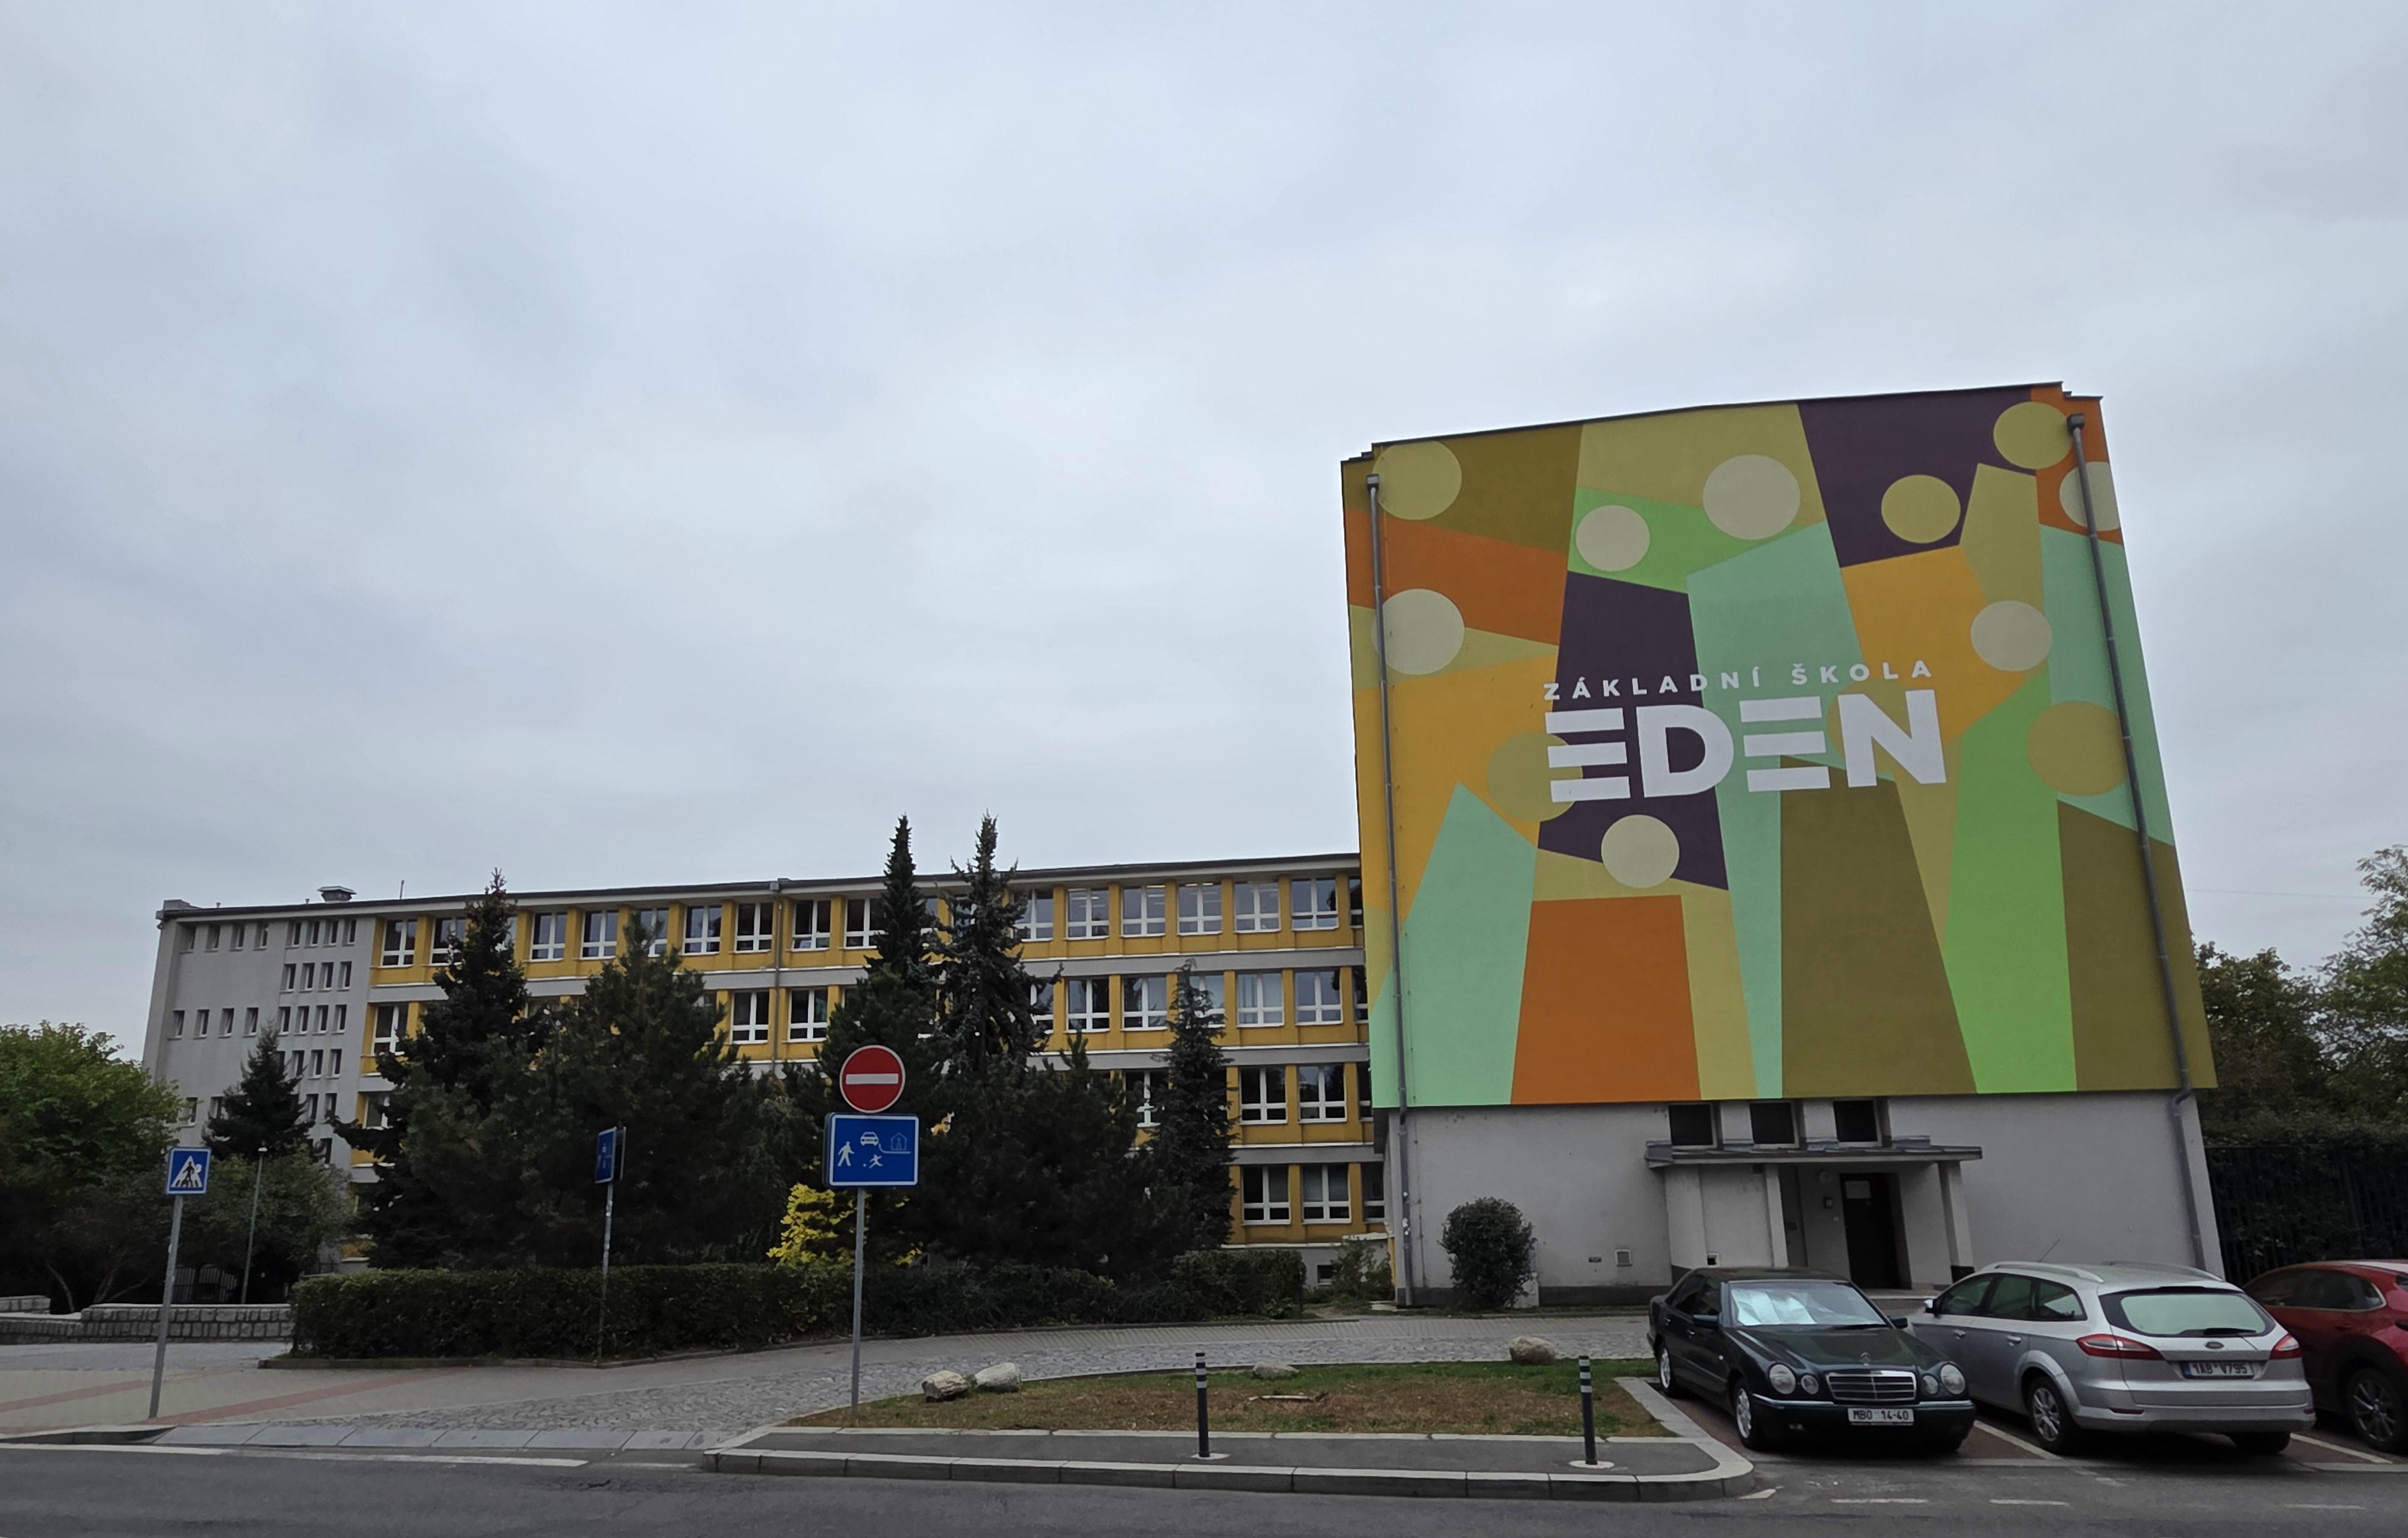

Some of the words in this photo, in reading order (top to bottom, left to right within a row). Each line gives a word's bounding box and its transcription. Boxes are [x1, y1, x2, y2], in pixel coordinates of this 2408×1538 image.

[1544, 666, 1760, 700] ZÁKLADNÍ
[1792, 660, 1931, 685] ŠKOLA
[1545, 690, 1946, 803] EDEN
[1881, 1410, 1909, 1420] 14-40
